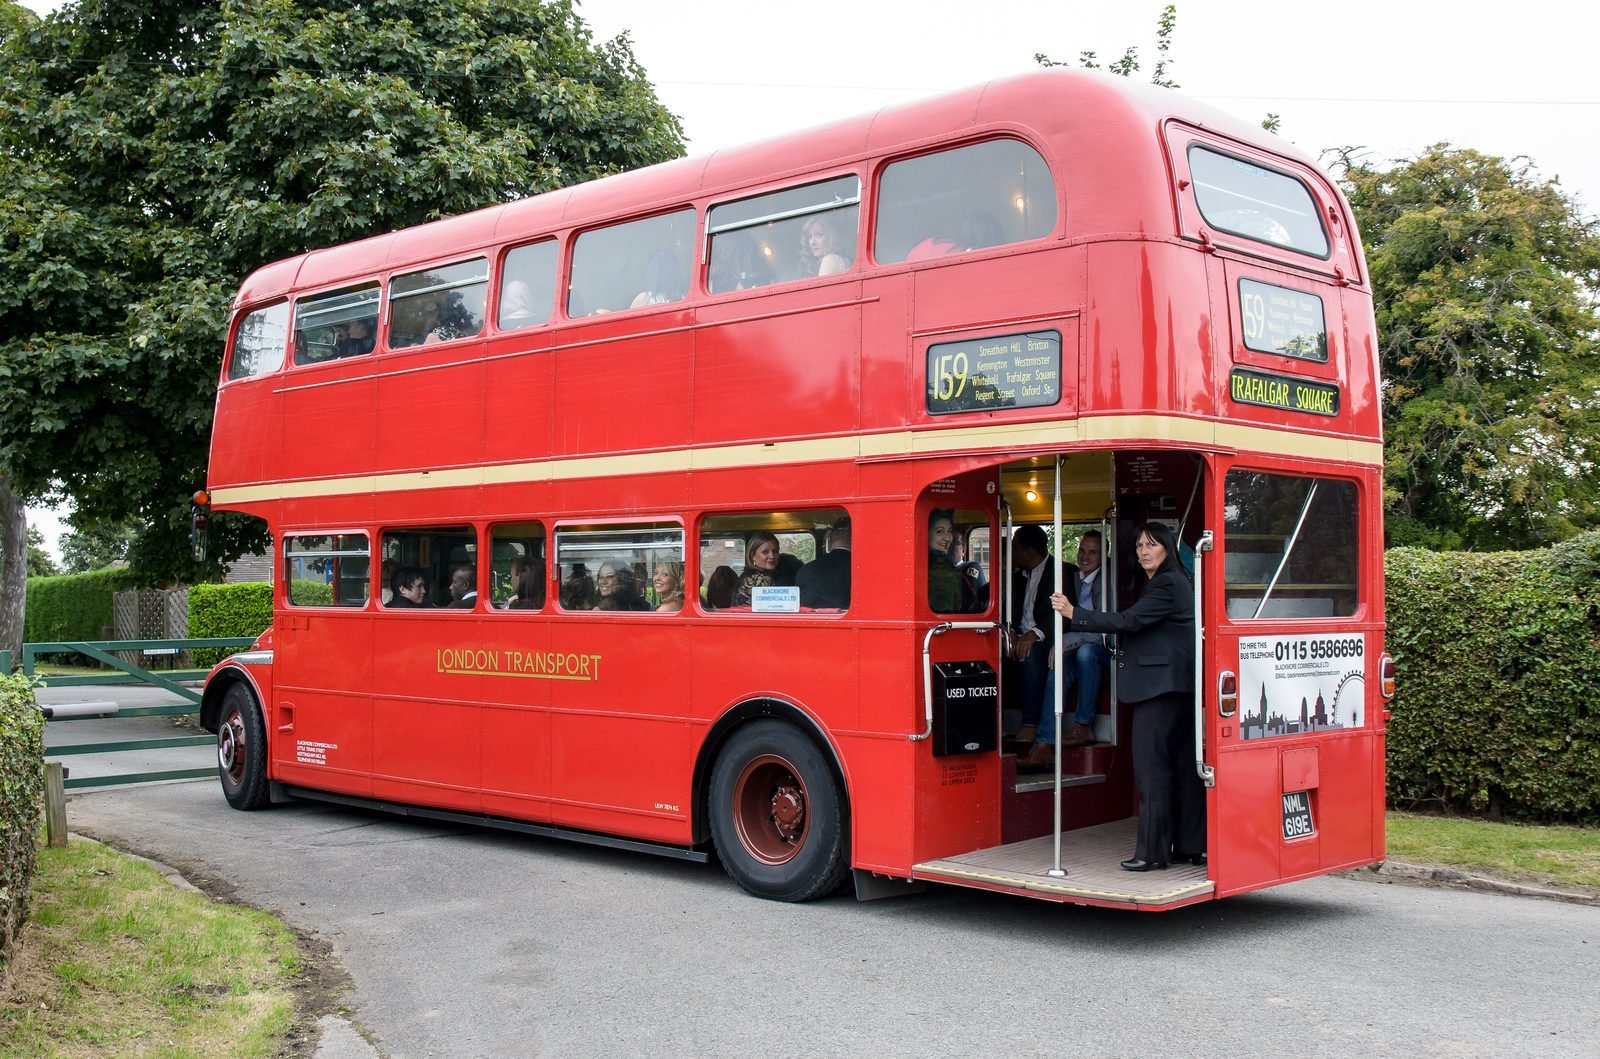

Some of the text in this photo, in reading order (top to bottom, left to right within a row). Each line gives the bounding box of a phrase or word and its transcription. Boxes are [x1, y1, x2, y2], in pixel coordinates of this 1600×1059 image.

[979, 340, 1049, 357] Streatham Hill Brixton
[976, 355, 1051, 372] Kennington Westminster
[933, 352, 969, 400] 159
[971, 369, 1056, 387] Whitehall Trafalgar Square
[975, 390, 995, 403] Regent
[1021, 385, 1041, 397] Oxford
[1231, 374, 1334, 414] TRAFALGAR SQUARE
[1240, 641, 1267, 650] TO HIRE THIS
[1275, 638, 1363, 662] 0115 9586696
[437, 648, 602, 681] LONDON TRANSPORT
[1240, 651, 1274, 660] BUS TELEPHONE
[1297, 662, 1322, 670] COMMERCIALS
[946, 686, 997, 699] USED TICKETS
[1283, 794, 1306, 814] NML
[1285, 814, 1311, 836] 619E
